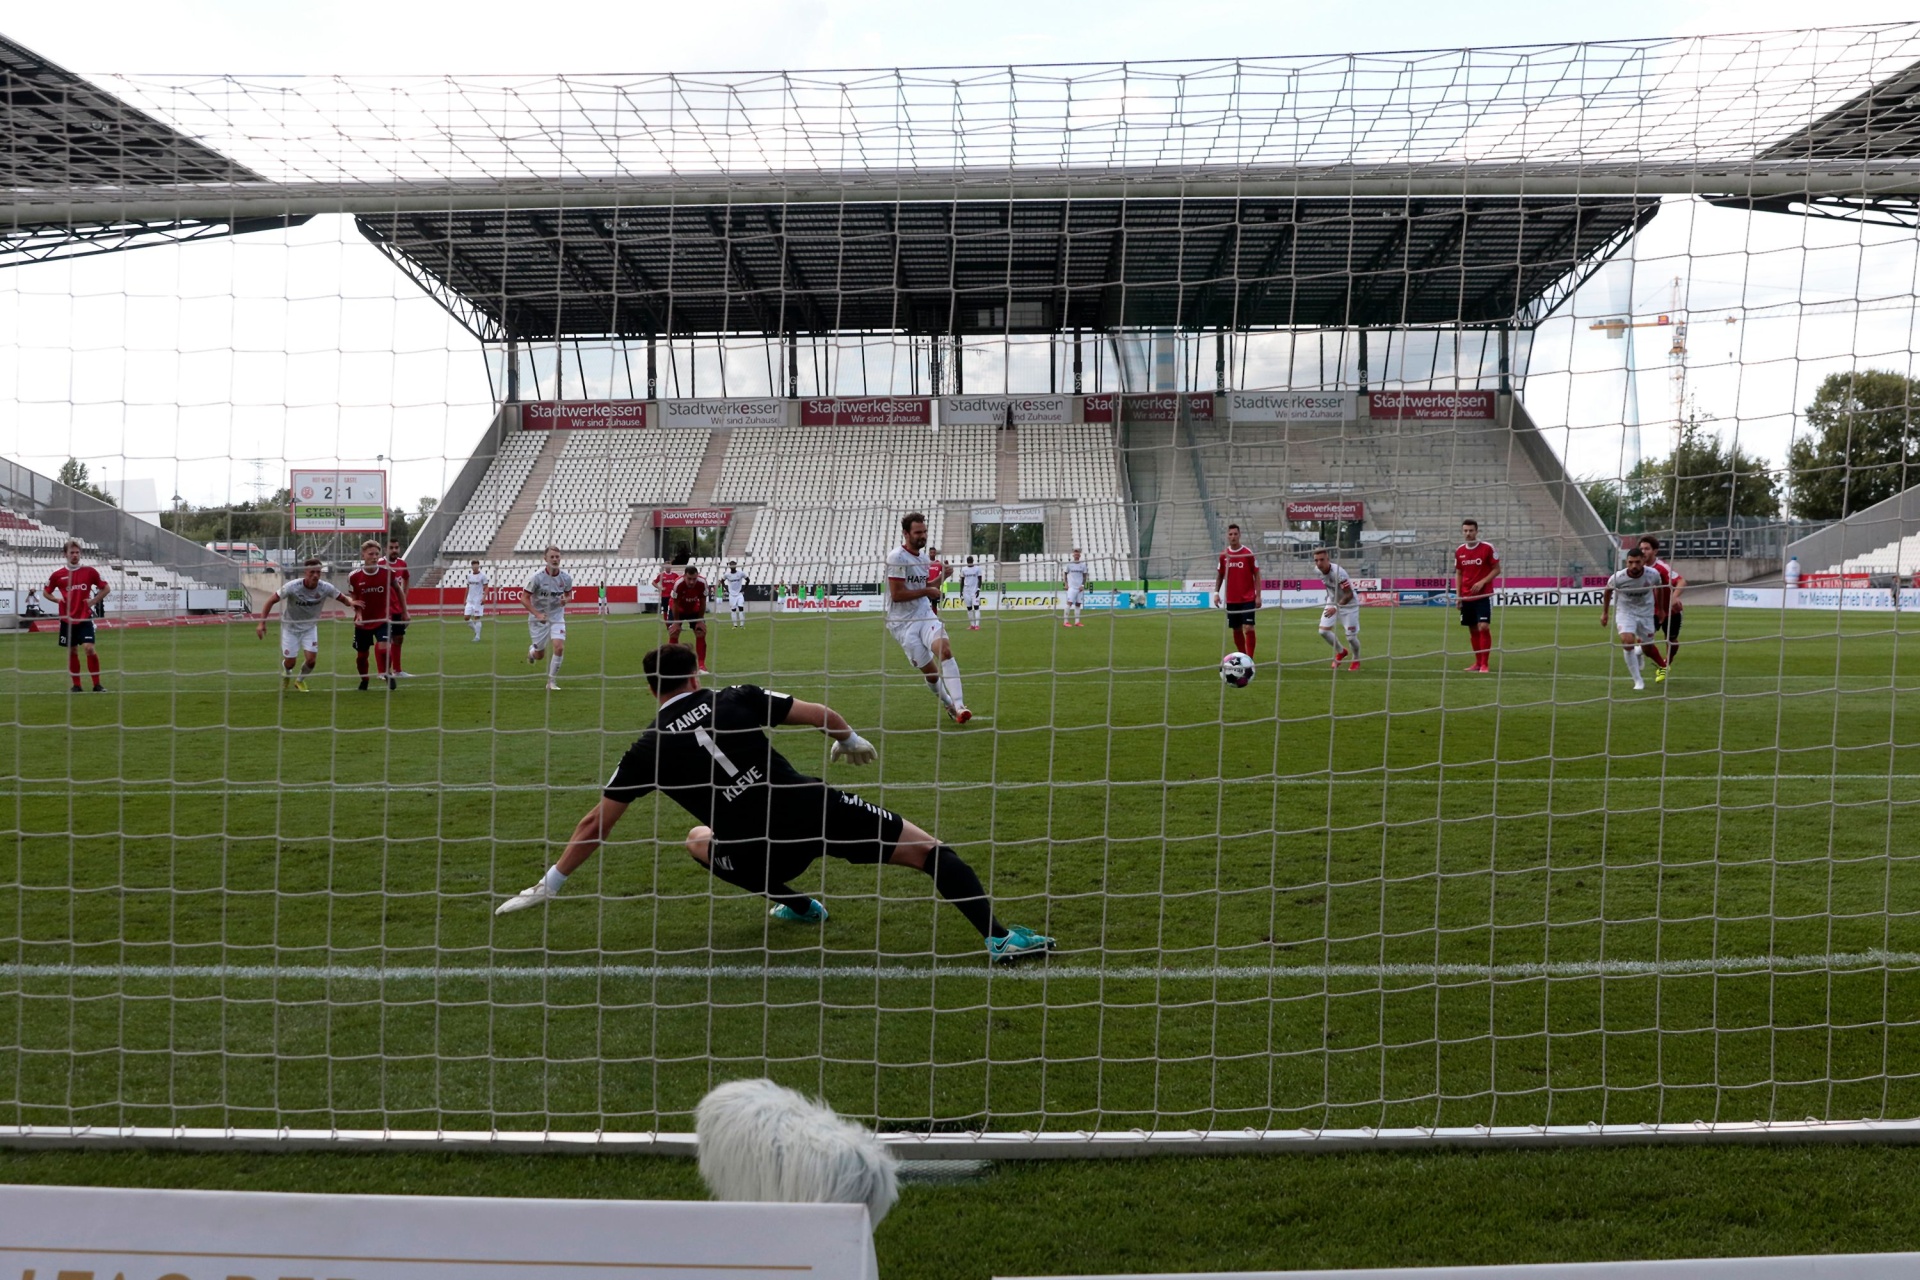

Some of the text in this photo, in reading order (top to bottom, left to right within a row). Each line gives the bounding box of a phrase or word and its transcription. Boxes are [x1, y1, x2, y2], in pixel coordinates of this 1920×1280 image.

[809, 399, 922, 413] Stadtwerkessen
[951, 400, 1063, 412] Stadtwerkessen
[1233, 396, 1345, 408] Stadtwerkessen
[1373, 394, 1486, 407] Stadtwerkessen
[530, 404, 641, 417] Stadtwerkessen
[669, 402, 781, 416] Stadtwerkessen
[1133, 411, 1147, 419] Wir
[1149, 411, 1165, 419] sind
[1291, 410, 1308, 418] sind
[1416, 409, 1429, 417] Wir
[1431, 409, 1448, 417] sind
[571, 419, 585, 427] Wir
[587, 419, 603, 427] sind
[851, 414, 922, 423] Wir sind Zuhause.
[324, 486, 332, 499] 2
[346, 486, 351, 499] 1
[1290, 504, 1355, 513] Stadtwerkessen
[1496, 592, 1560, 605] HARFID
[1567, 592, 1614, 605] HAR
[666, 703, 712, 734] TANER
[694, 725, 739, 777] 1
[722, 766, 762, 802] KLEVE
